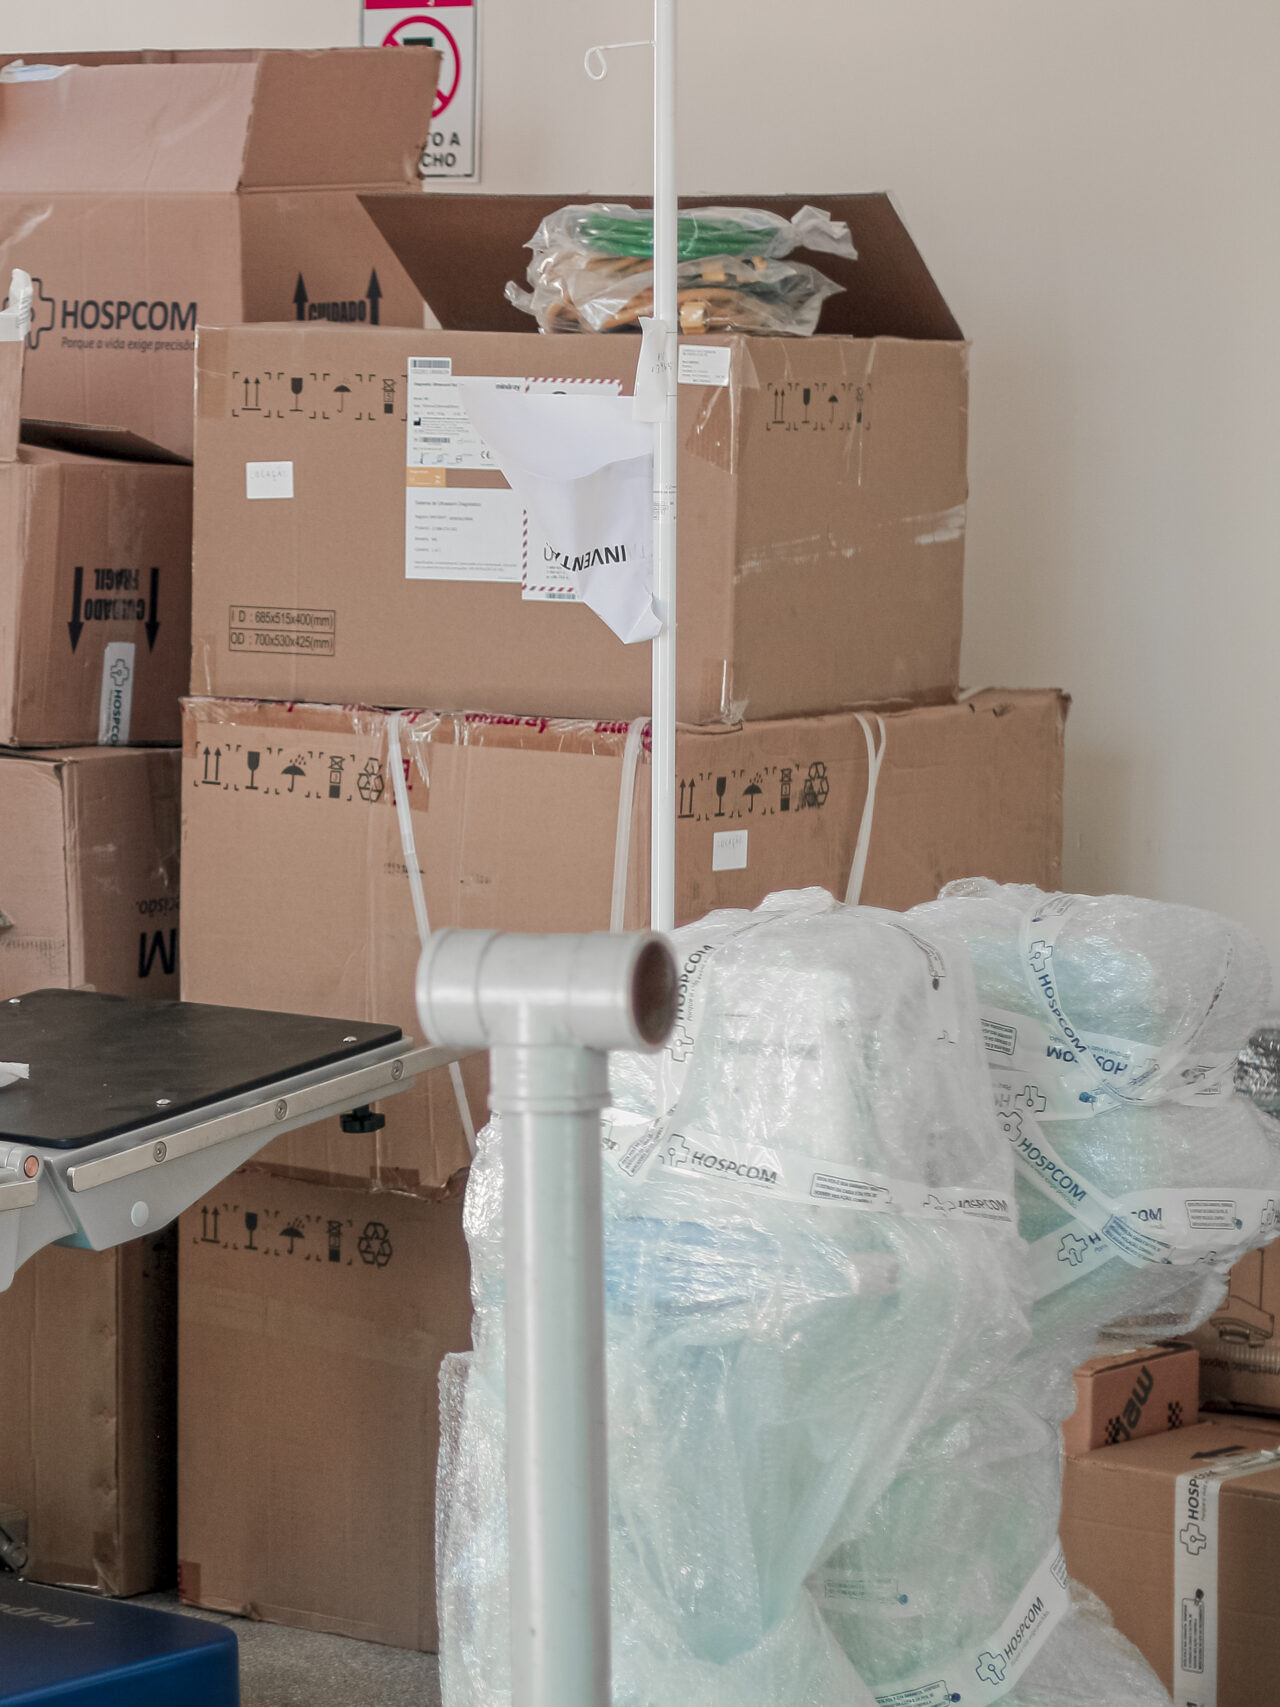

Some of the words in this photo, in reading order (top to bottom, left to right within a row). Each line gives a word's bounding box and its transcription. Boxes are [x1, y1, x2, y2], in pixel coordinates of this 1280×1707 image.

[428, 132, 444, 146] O
[450, 132, 460, 146] A
[61, 299, 197, 331] HOSPCOM
[61, 336, 94, 350] Porque
[106, 337, 125, 350] vida
[128, 340, 150, 352] exige
[1038, 973, 1087, 1053] HOSPCOM
[691, 1150, 778, 1185] HOSPCOM
[1017, 1137, 1088, 1202] HOSPCOM
[1003, 1596, 1046, 1661] HOSPCOM
